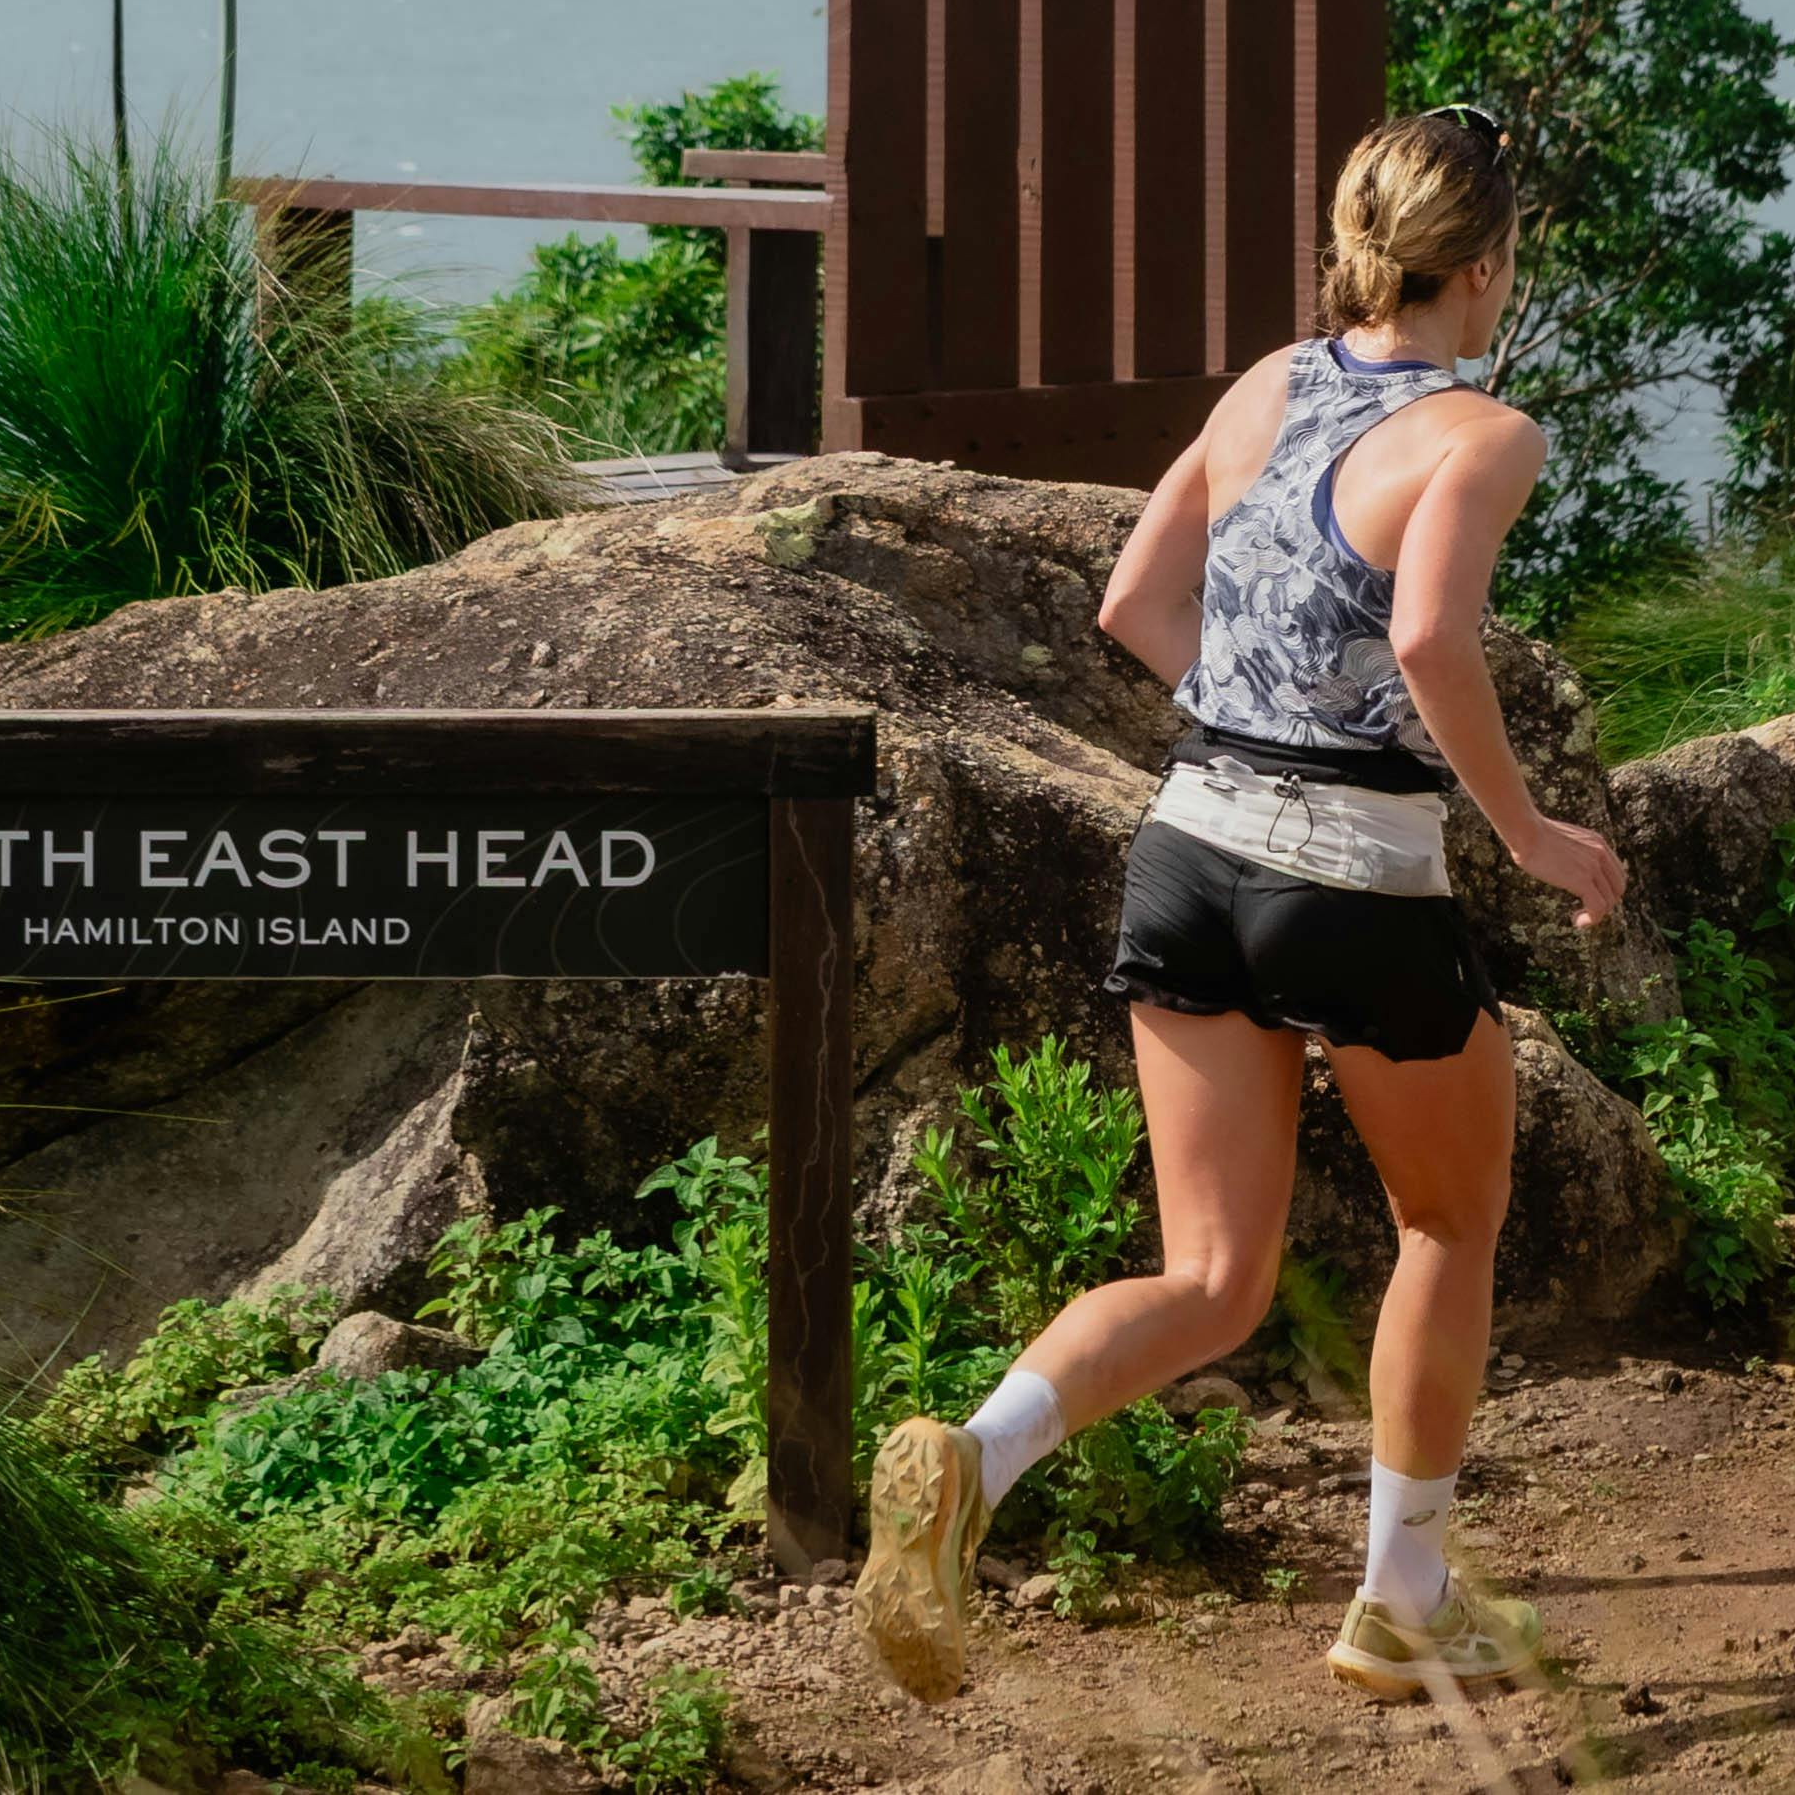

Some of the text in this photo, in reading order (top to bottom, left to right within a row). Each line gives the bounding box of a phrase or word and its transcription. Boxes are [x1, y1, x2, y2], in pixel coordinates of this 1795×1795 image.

[140, 829, 366, 888] EAST
[408, 830, 655, 887] HEAD
[25, 917, 410, 945] HAMILTON ISLAND
